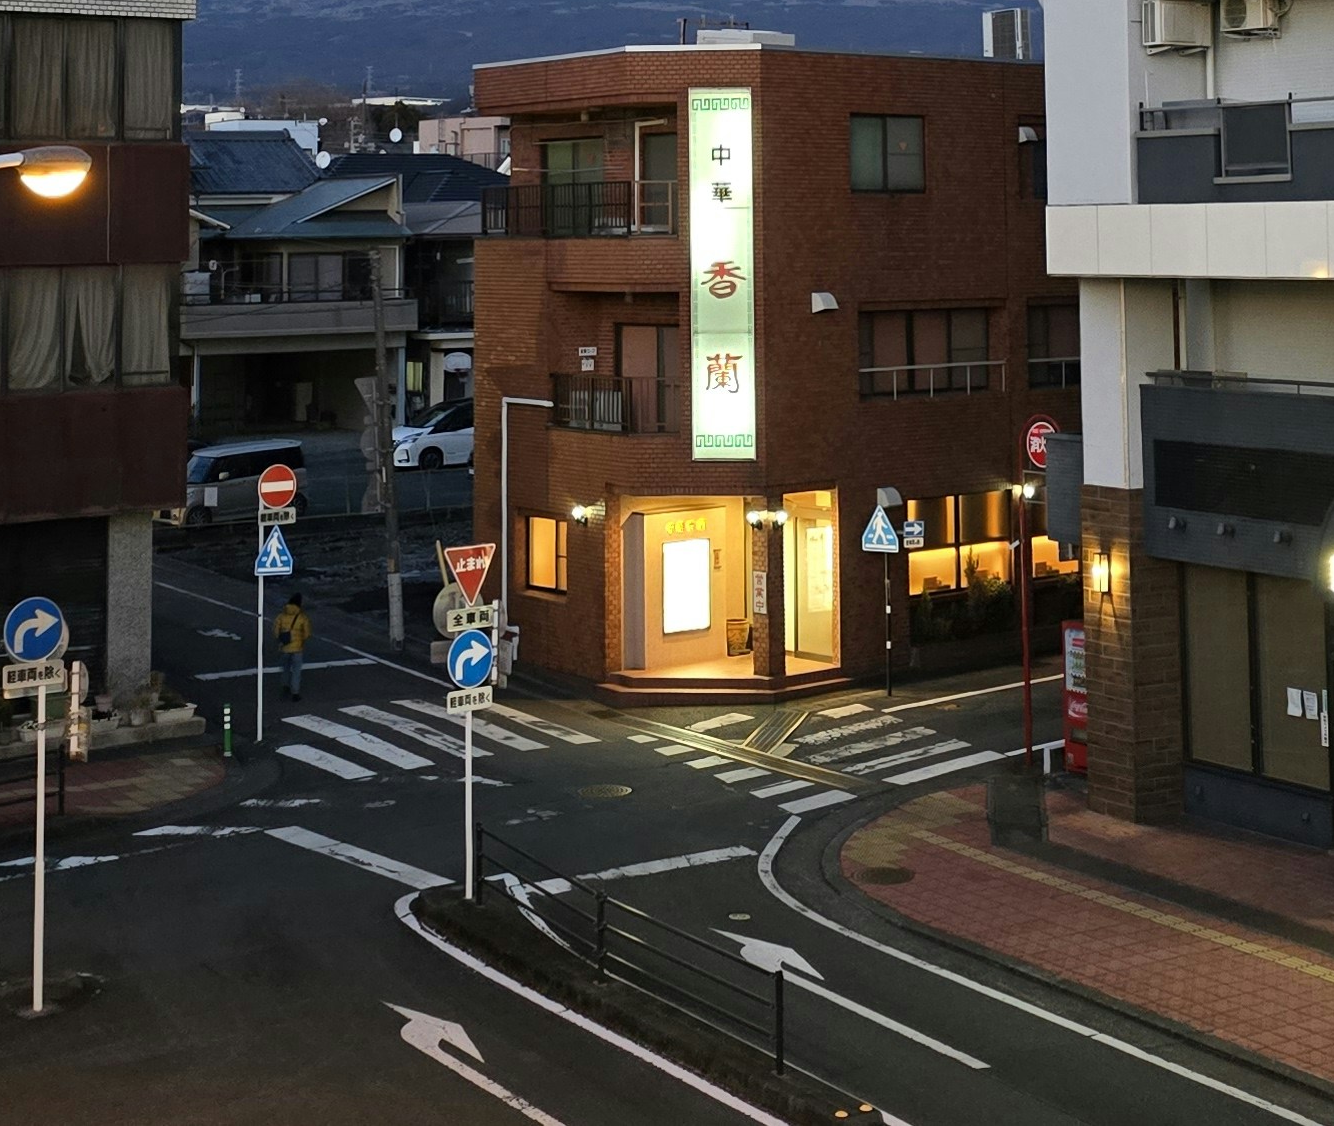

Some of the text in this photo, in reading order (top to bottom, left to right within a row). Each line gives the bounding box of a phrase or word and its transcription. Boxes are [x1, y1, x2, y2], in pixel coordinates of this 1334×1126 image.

[700, 143, 747, 394] 中華 香蘭
[455, 557, 486, 573] 止まれ
[452, 610, 490, 627] 全車両
[7, 665, 61, 684] 軽車両を除く
[450, 691, 491, 709] 軽車両を除く
